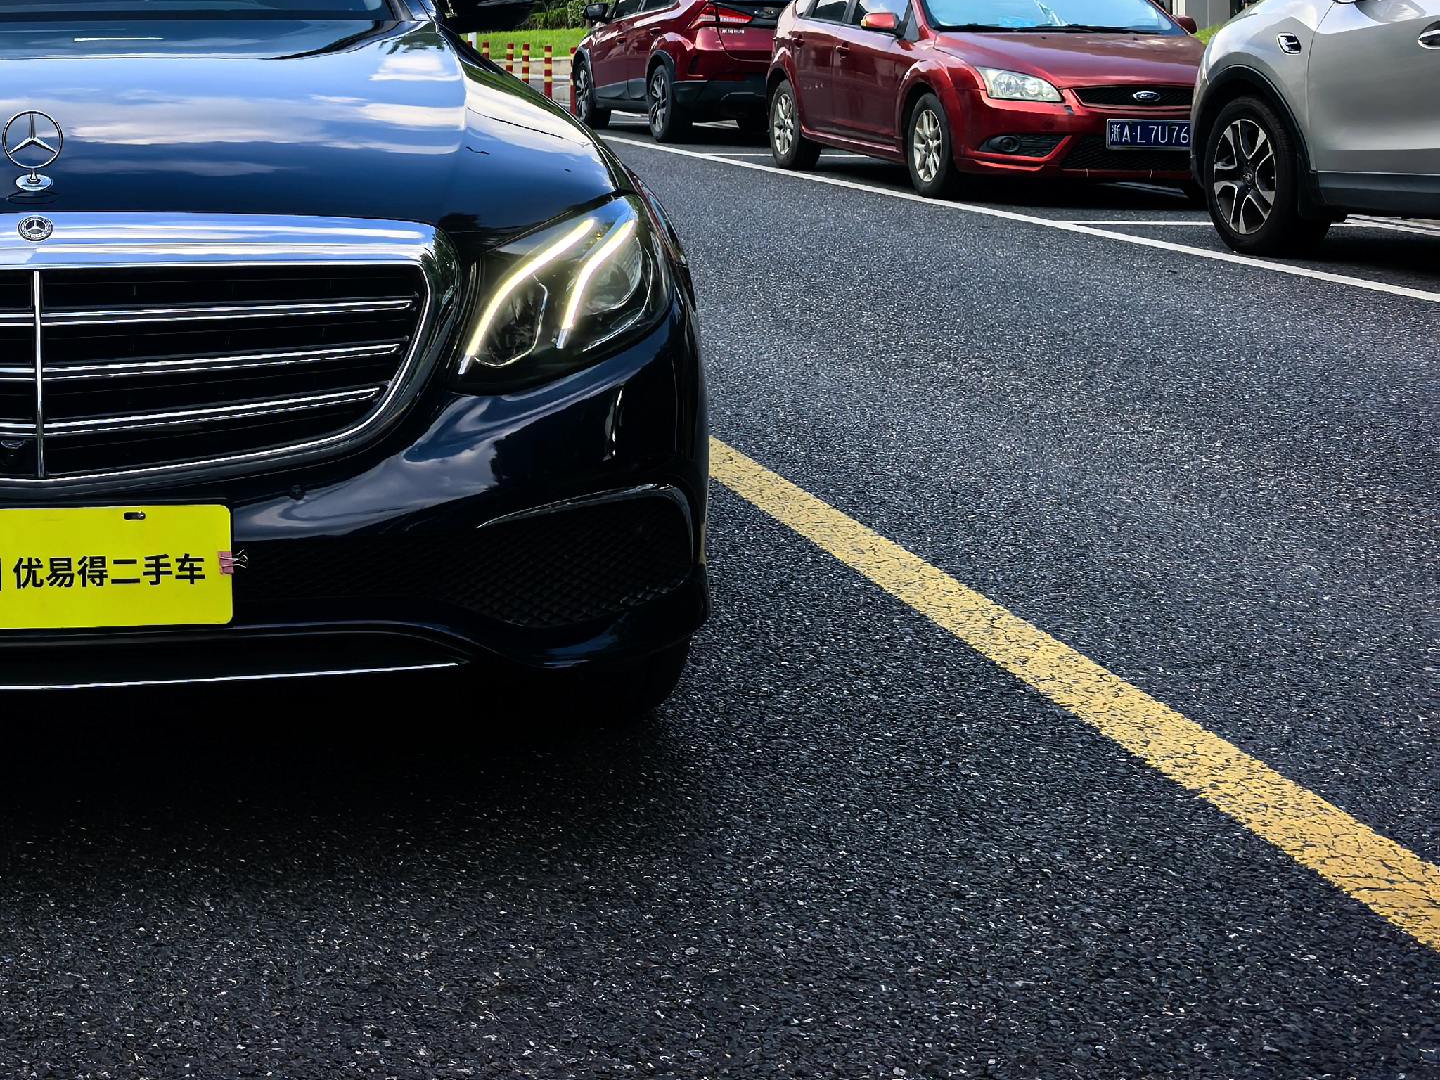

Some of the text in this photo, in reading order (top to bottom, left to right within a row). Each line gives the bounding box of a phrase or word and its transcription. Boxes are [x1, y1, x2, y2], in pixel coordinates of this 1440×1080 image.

[12, 552, 206, 589] 优易得二手车
